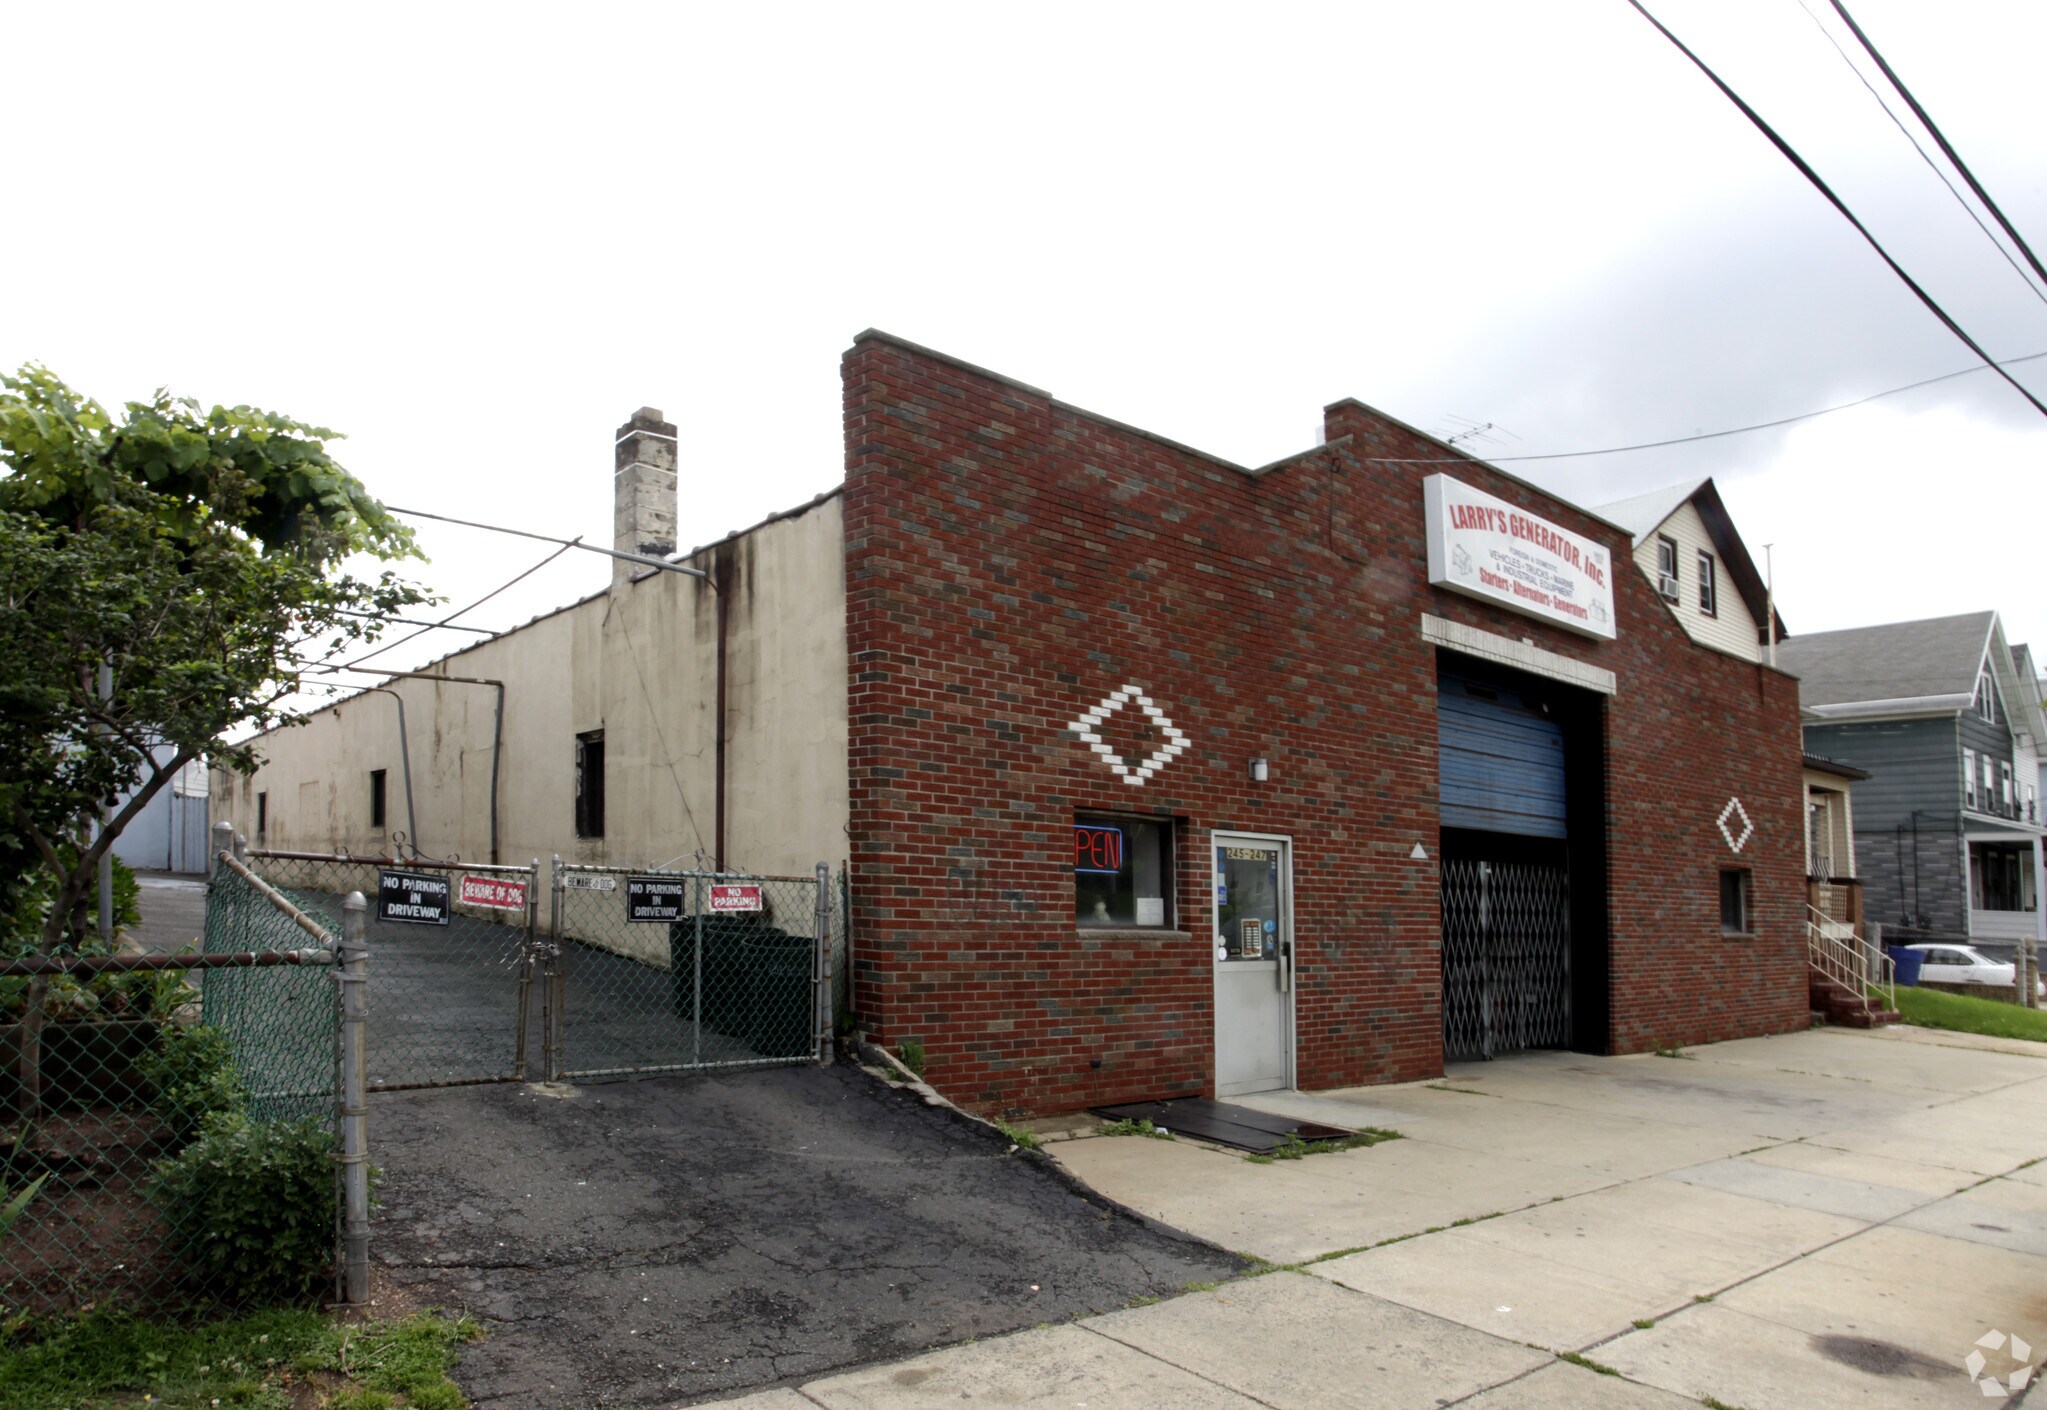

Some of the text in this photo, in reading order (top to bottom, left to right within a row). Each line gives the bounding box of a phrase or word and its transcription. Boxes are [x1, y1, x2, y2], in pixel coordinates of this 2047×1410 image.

[1450, 504, 1606, 589] LARRY'S GENERATOR, Inc.
[1489, 549, 1575, 591] VEHICLES TRUCKS MARINE
[1496, 562, 1574, 598] & INDUSTRIAL EQUIPMENT
[1479, 566, 1588, 621] Starters Alternators Generators
[1075, 829, 1120, 869] PEN
[1228, 848, 1266, 860] 245-247
[383, 876, 447, 894] NO PARKING
[568, 877, 592, 888] BEWARE
[600, 878, 613, 890] DOG
[630, 883, 682, 895] NO PARKING
[410, 892, 421, 904] IN
[465, 882, 523, 903] BEWARE OF DOG
[727, 888, 742, 897] NO
[652, 895, 662, 906] IN
[714, 897, 756, 906] PARKING
[388, 904, 441, 919] DRIVEWAY
[635, 906, 678, 917] DRIVEWAY
